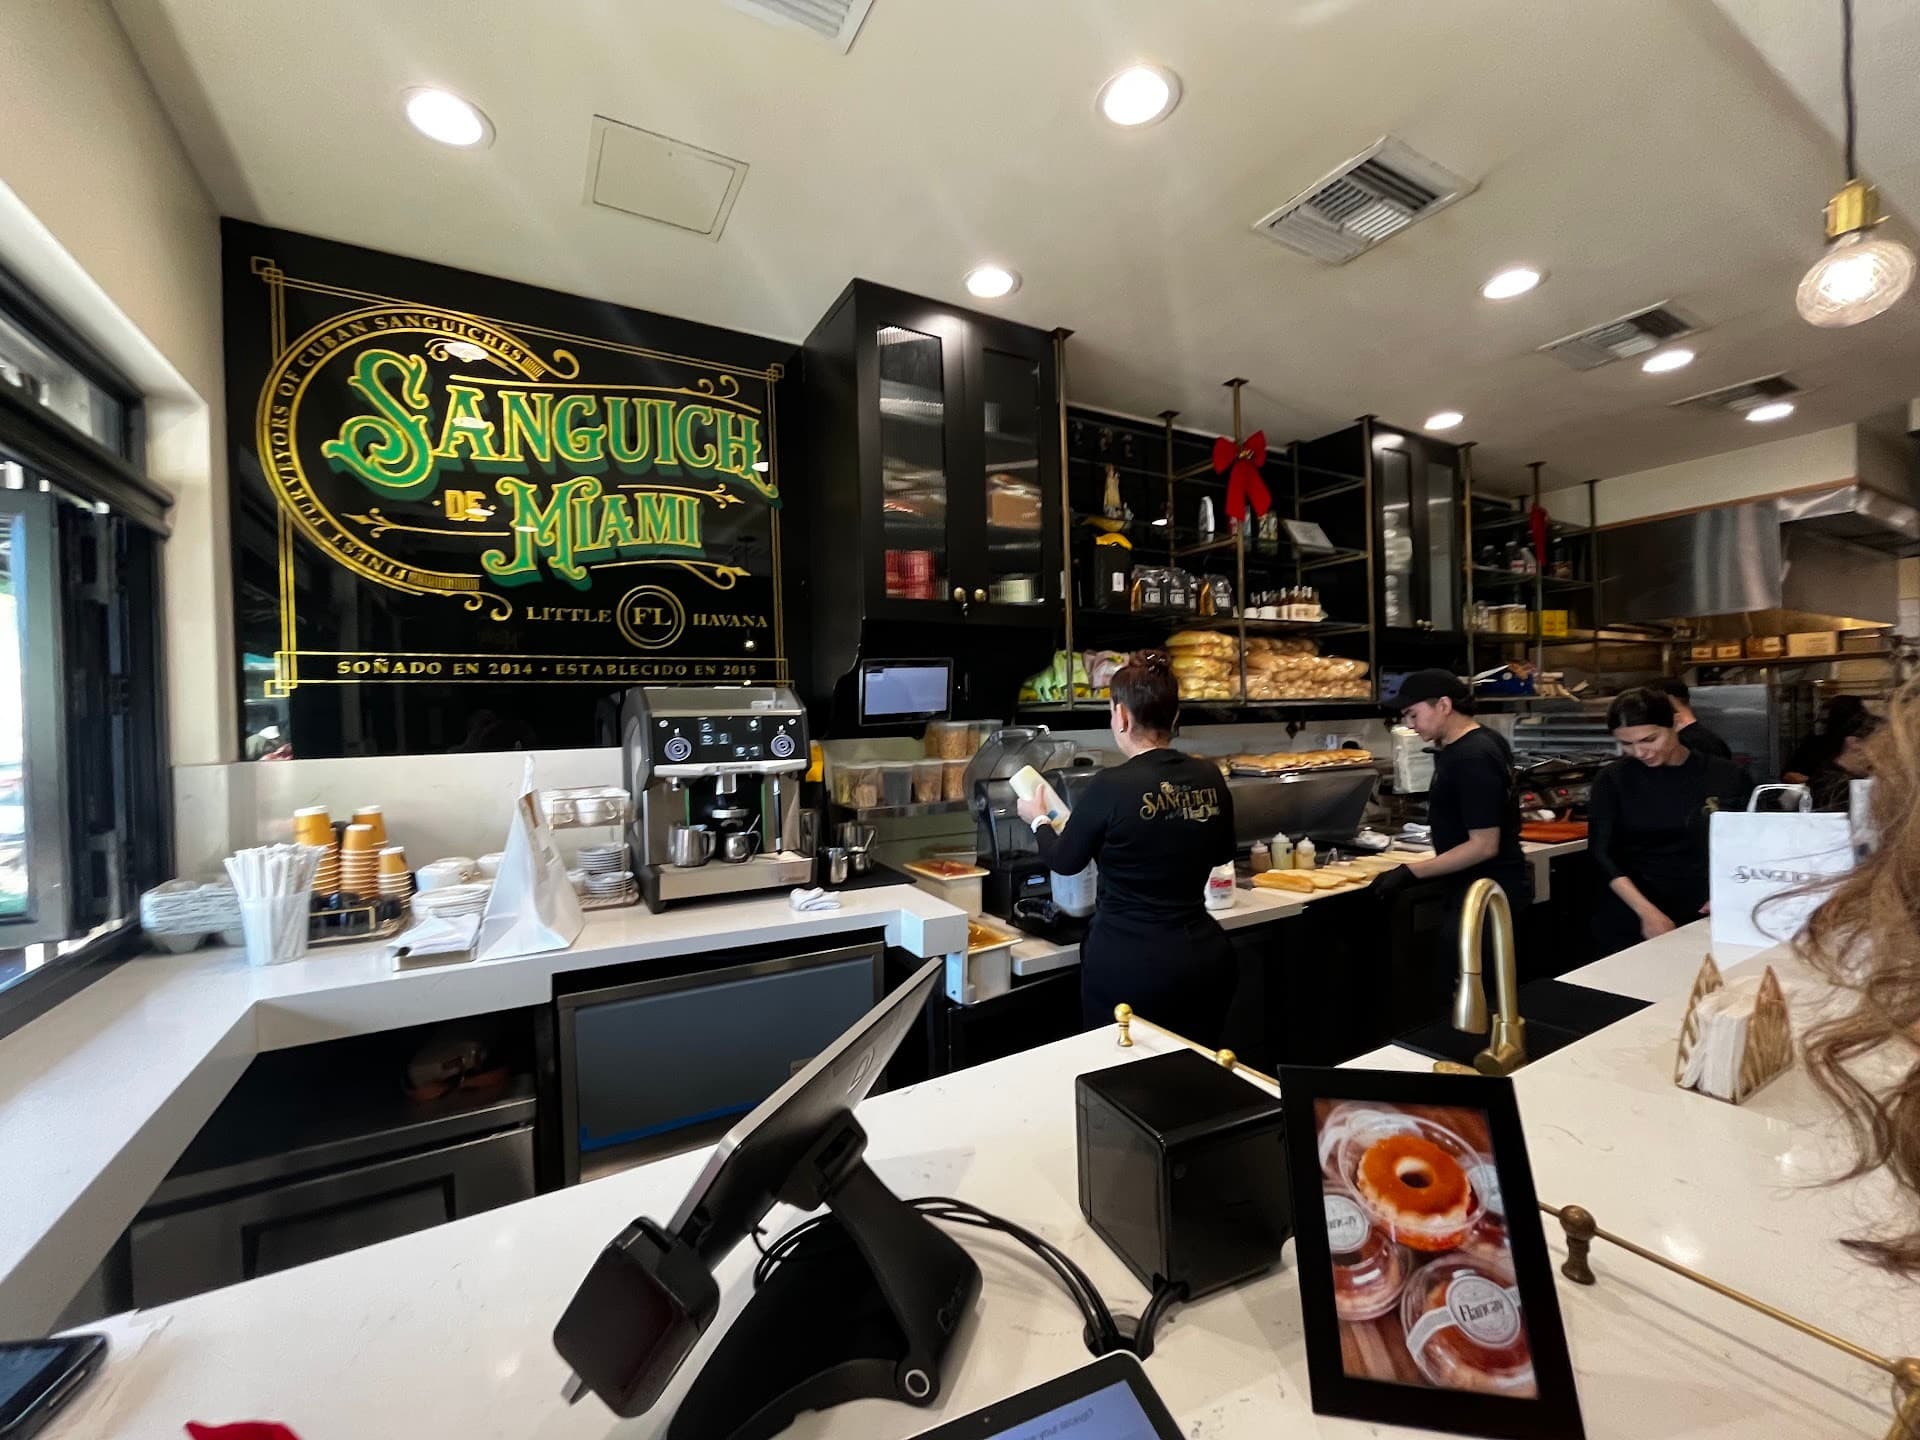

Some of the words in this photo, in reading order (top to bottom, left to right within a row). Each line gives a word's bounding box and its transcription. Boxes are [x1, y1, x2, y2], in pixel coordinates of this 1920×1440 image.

[298, 320, 368, 368] CUBAN
[373, 313, 523, 360] SANGUICHES
[278, 370, 300, 397] OF
[320, 348, 780, 499] SANGUICH
[271, 405, 327, 527] PURVEYORS
[444, 489, 488, 522] DE
[481, 476, 703, 581] MIAMI
[328, 532, 409, 582] FINEST
[526, 605, 613, 623] LITTLE
[632, 606, 673, 627] FL
[692, 612, 769, 628] HAVANA
[336, 657, 443, 675] SOÑADO
[453, 662, 480, 676] EN
[488, 662, 533, 676] 2014
[555, 662, 688, 677] ESTABLECIDO
[695, 663, 716, 677] EN
[722, 663, 758, 677] 2015
